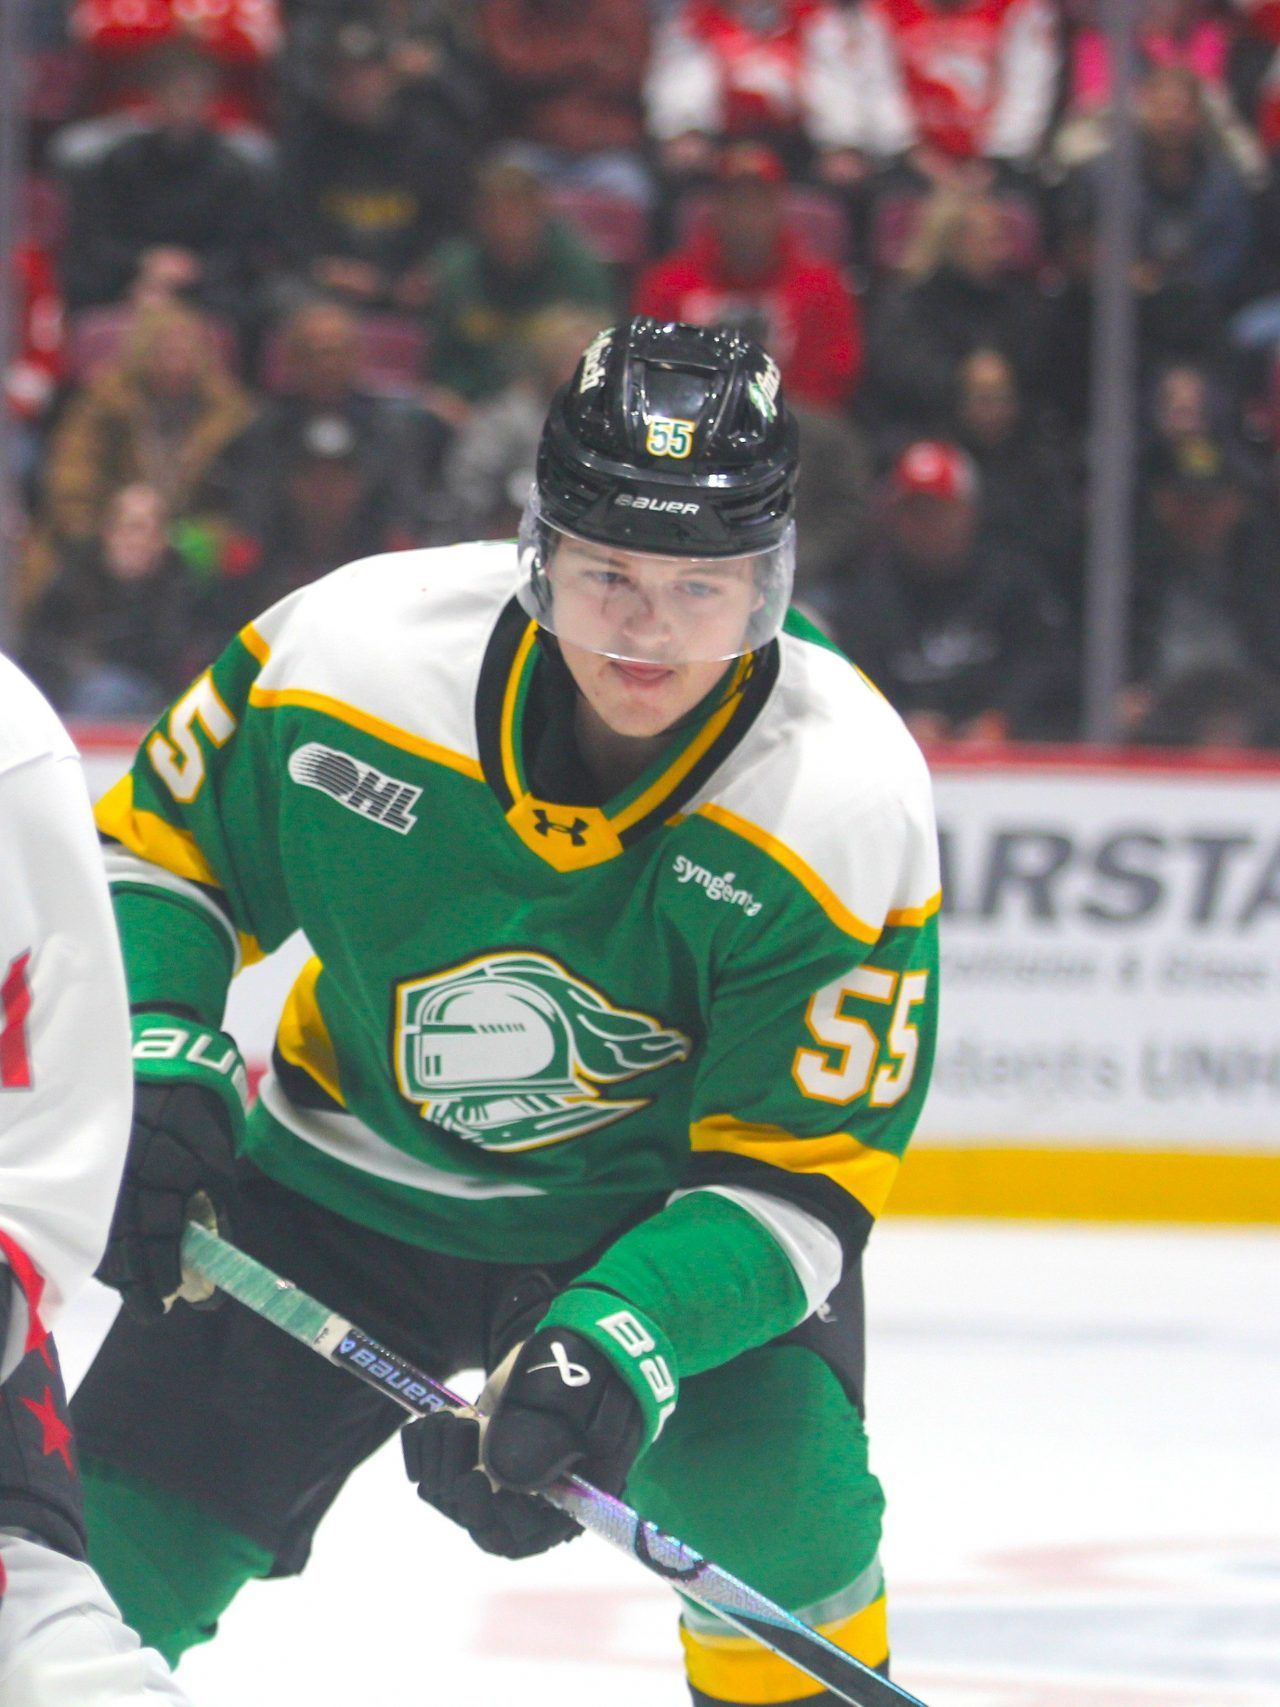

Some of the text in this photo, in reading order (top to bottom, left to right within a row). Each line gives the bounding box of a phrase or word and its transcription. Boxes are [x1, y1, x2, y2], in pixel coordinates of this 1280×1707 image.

[646, 419, 696, 459] 55
[614, 493, 700, 516] BAUER
[287, 741, 424, 836] OHL
[672, 854, 763, 918] syngenta
[791, 964, 931, 1108] 55
[349, 1348, 445, 1412] BAUER
